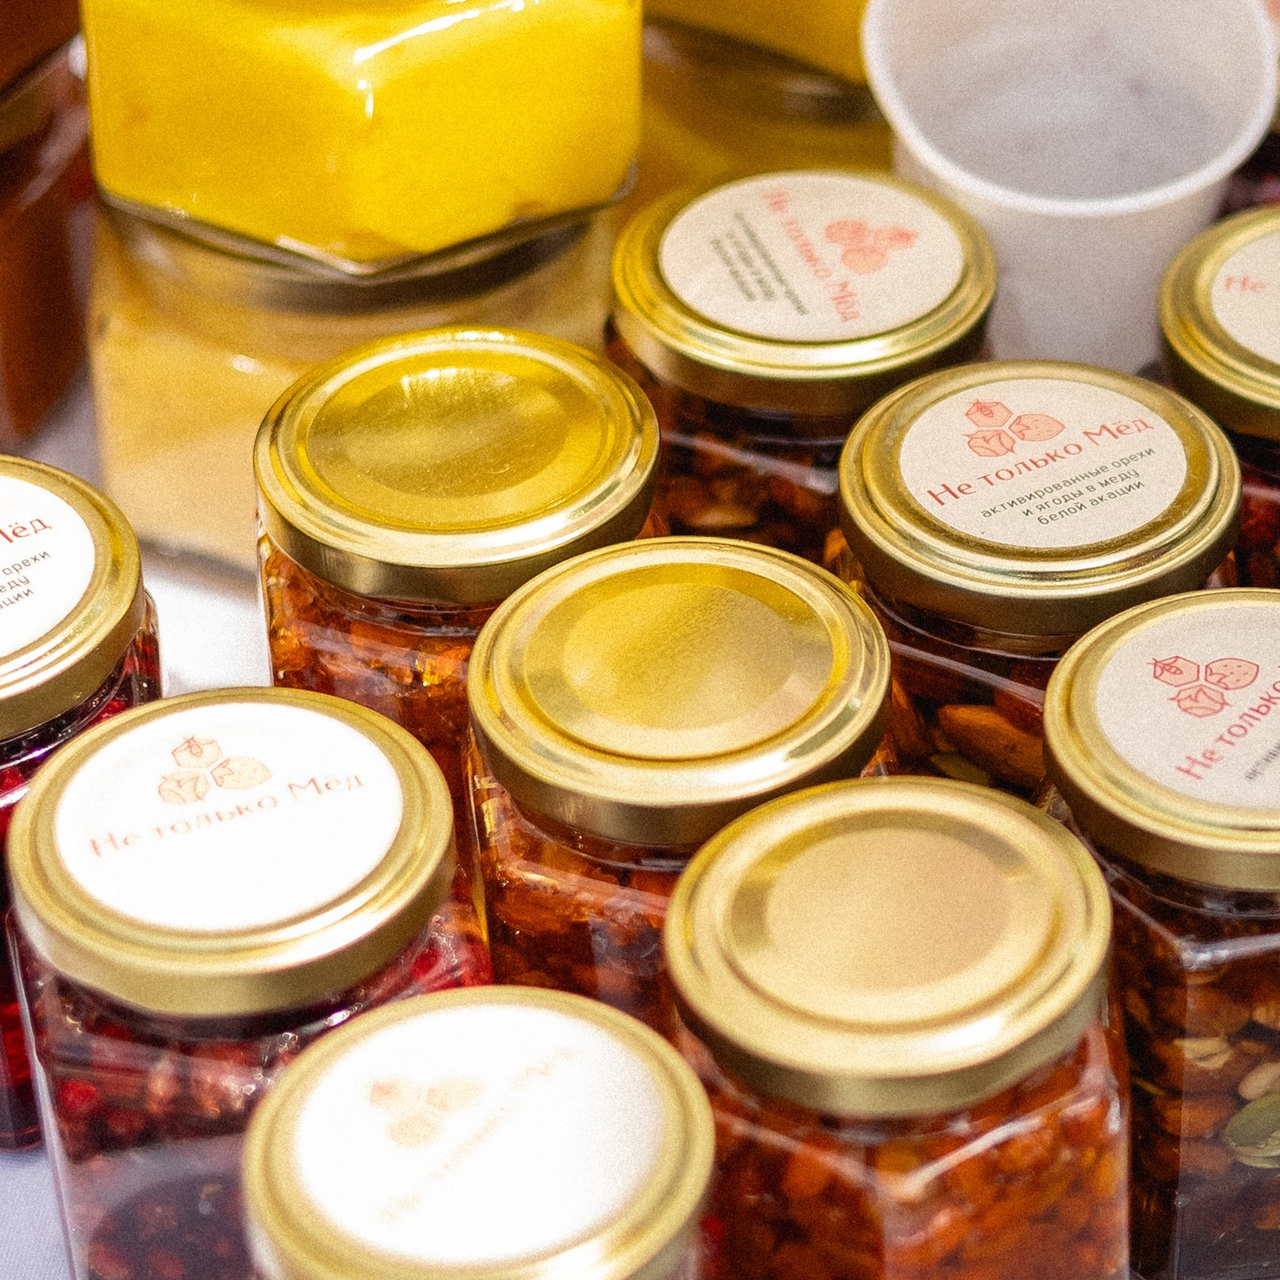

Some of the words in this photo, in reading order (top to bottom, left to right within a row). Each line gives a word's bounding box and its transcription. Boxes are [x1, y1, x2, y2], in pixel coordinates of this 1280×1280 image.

[927, 480, 977, 507] Не
[976, 442, 1083, 488] только
[1082, 416, 1155, 447] Мёд
[980, 463, 1110, 519] активированные
[1111, 447, 1156, 471] орехи
[1022, 507, 1034, 518] и
[1036, 487, 1085, 513] ягоды
[1088, 483, 1097, 494] в
[1098, 468, 1141, 490] меду
[1037, 501, 1087, 526] белой
[1090, 480, 1146, 507] акации
[0, 518, 52, 544] ёд
[2, 550, 50, 577] орехи
[0, 575, 30, 594] еду
[1174, 747, 1225, 781] Не
